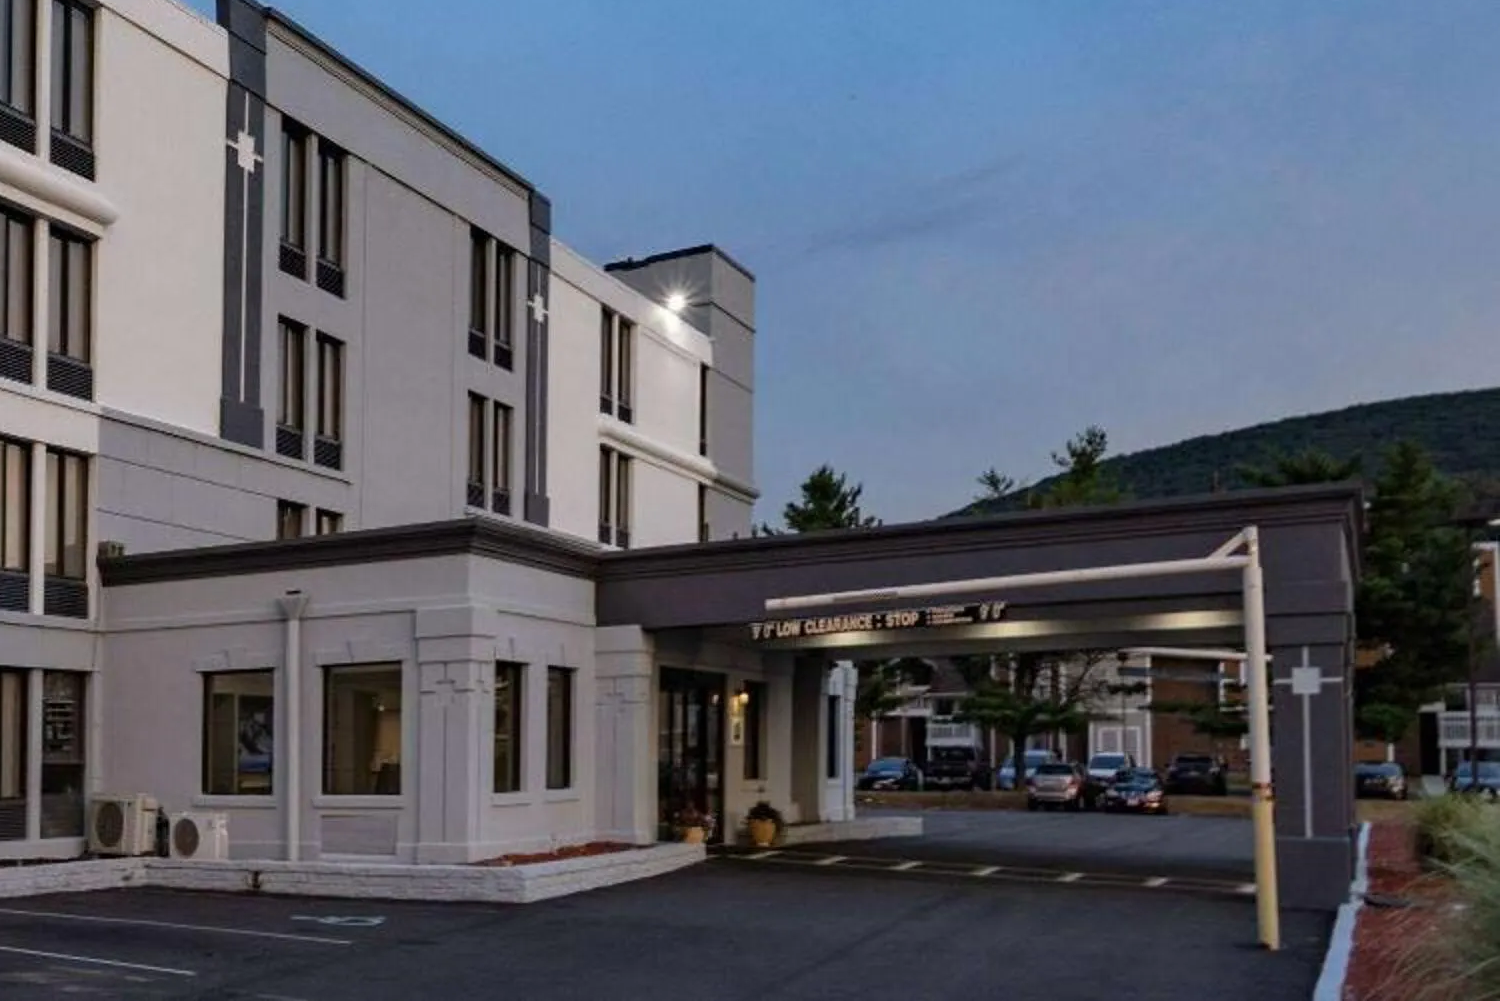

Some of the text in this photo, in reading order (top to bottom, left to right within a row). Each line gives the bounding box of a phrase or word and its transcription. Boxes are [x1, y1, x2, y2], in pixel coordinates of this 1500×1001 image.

[776, 620, 801, 637] LOW
[805, 615, 873, 634] CLEARANCE
[885, 611, 919, 628] STOP
